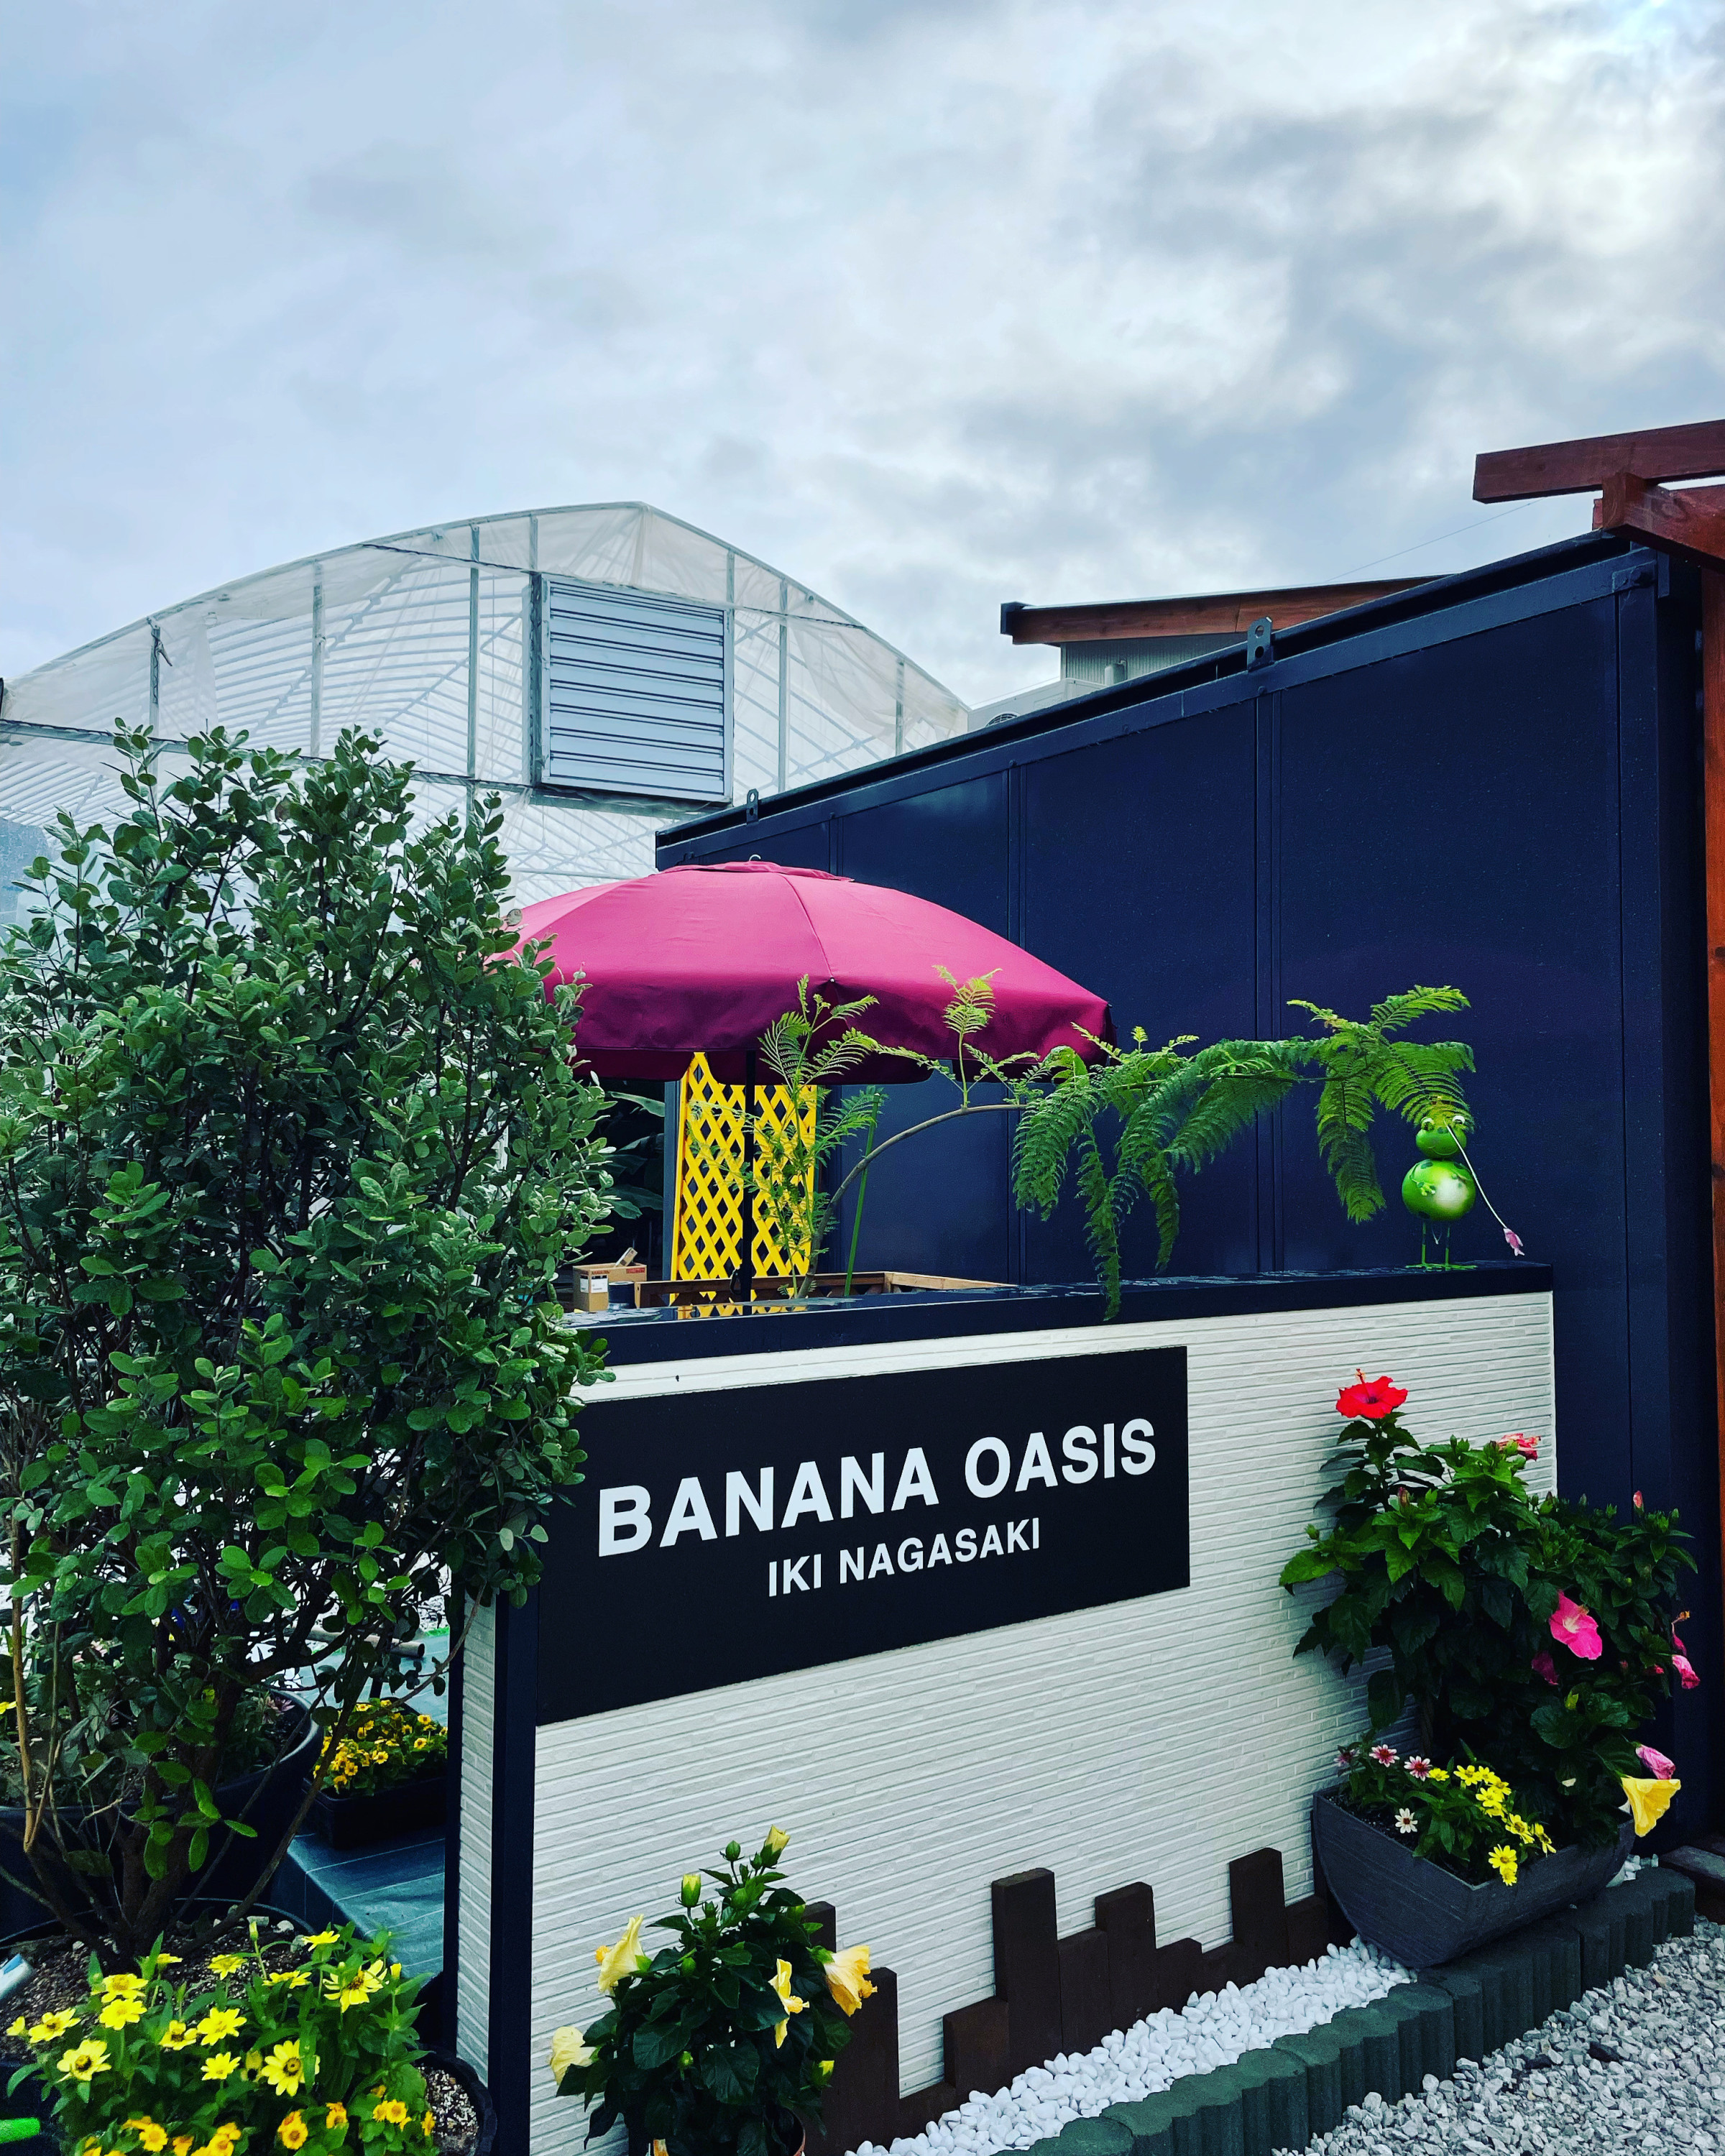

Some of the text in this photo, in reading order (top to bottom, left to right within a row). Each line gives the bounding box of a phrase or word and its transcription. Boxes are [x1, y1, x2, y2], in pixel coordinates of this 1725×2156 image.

[598, 1418, 1156, 1557] BANANA OASIS
[768, 1517, 1040, 1597] IKI NAGASAKI
